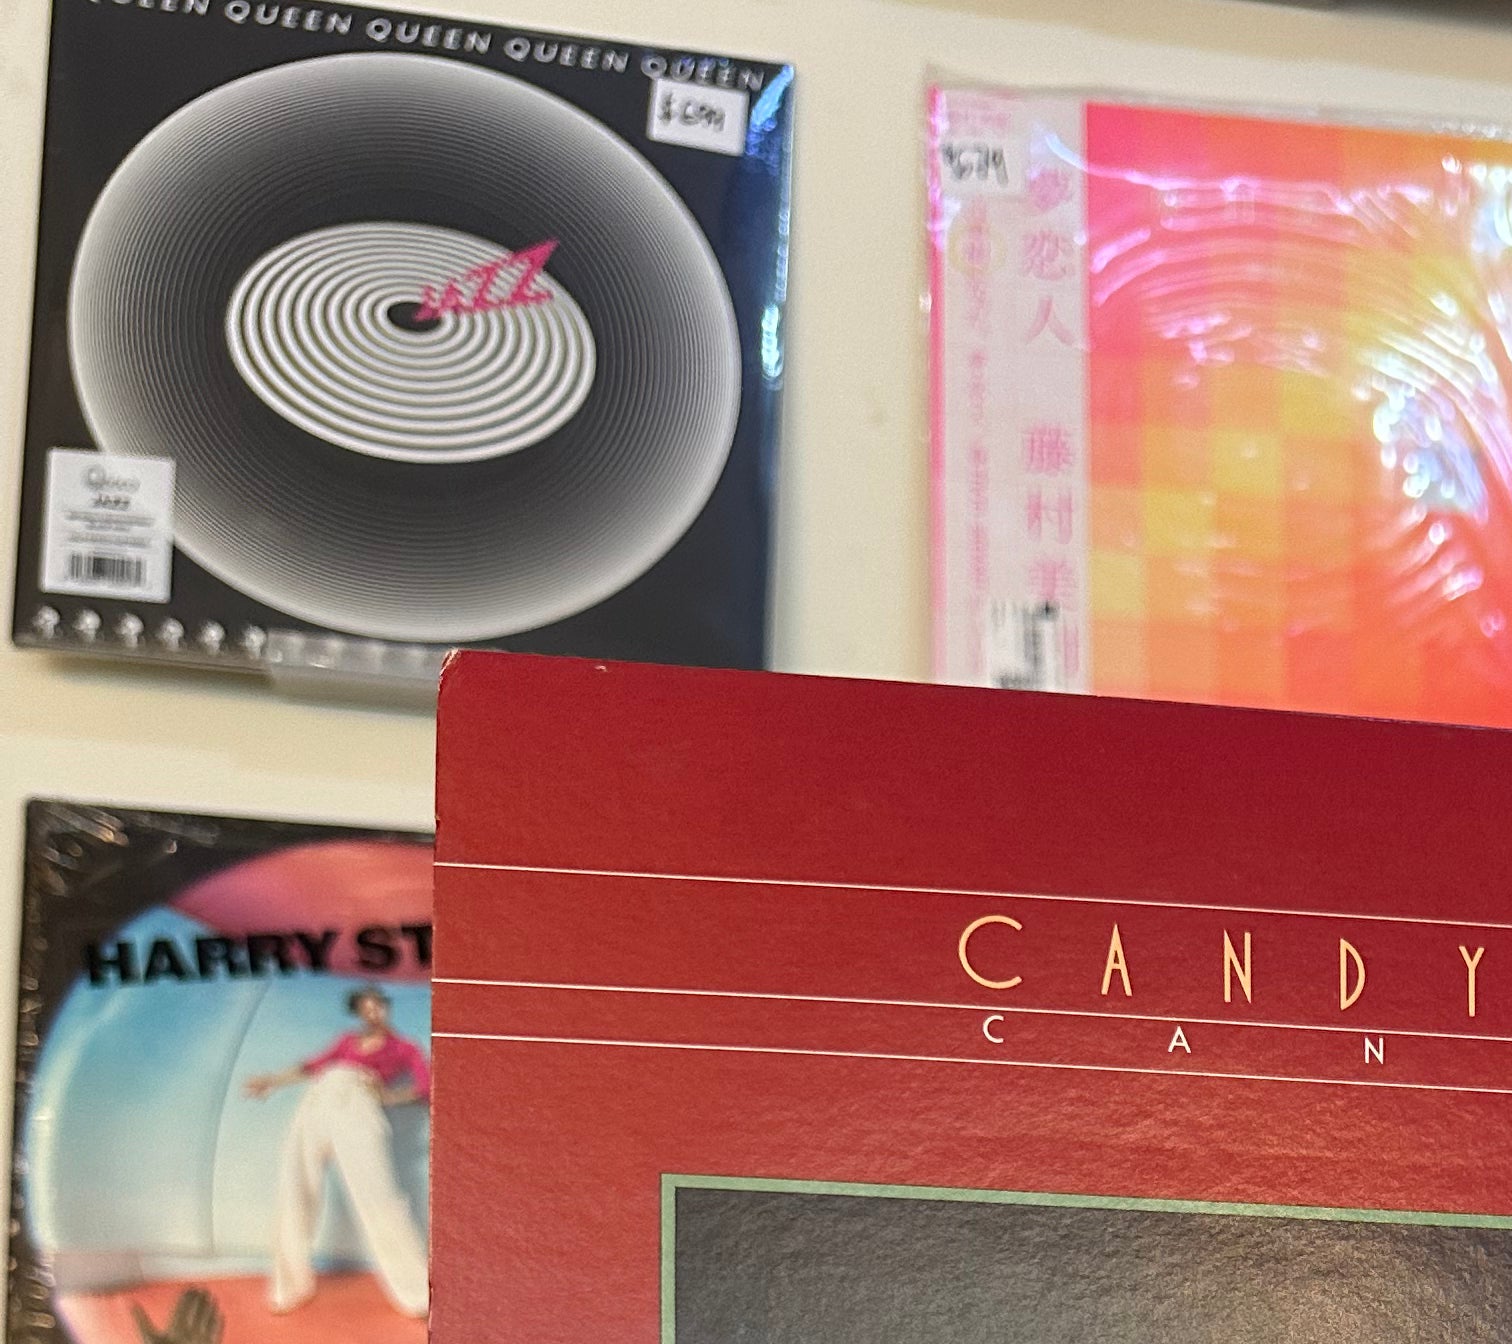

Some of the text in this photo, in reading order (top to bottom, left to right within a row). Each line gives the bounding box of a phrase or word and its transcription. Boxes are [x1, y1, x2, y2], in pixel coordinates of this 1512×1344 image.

[224, 1, 352, 35] QUEEN
[366, 17, 491, 55] QUEEN
[503, 36, 629, 74] QUEEN
[640, 54, 765, 91] QUEEN
[87, 928, 338, 986] HARRY
[958, 914, 1485, 1018] CANDY
